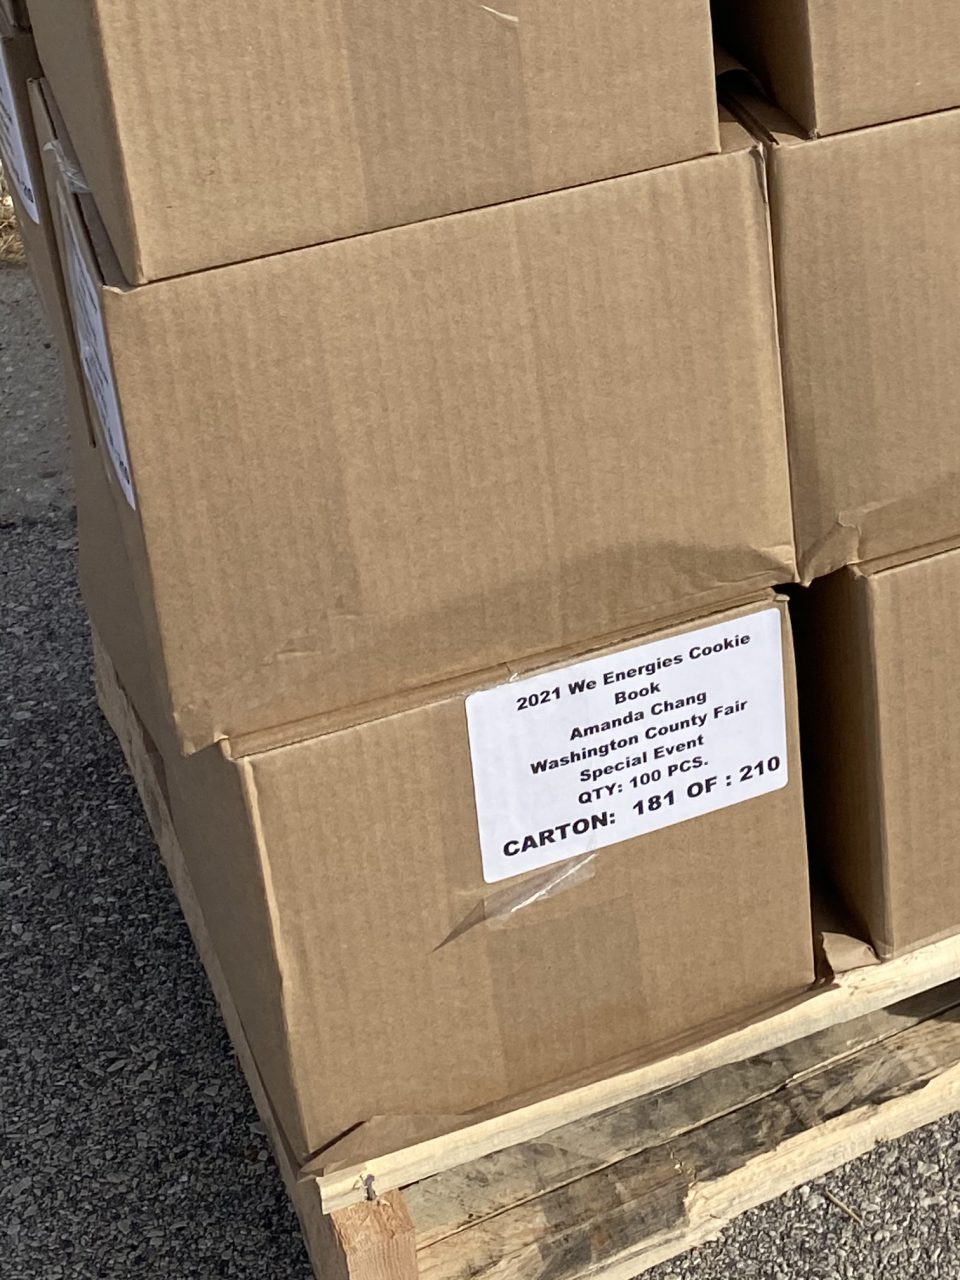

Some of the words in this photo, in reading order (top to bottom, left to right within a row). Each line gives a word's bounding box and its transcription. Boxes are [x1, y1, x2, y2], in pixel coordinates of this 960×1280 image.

[516, 686, 561, 712] 2021
[567, 678, 597, 696] We
[602, 654, 684, 686] Energies
[688, 634, 751, 660] Cookie
[614, 681, 661, 705] Book
[529, 734, 639, 775] Washington
[644, 713, 708, 740] County
[713, 700, 748, 720] Fair
[569, 710, 645, 741] Amanda
[650, 691, 707, 716] Chang
[578, 782, 623, 805] QTY:
[629, 769, 662, 789] 100
[667, 755, 709, 778] PCS.
[579, 751, 648, 782] Special
[653, 734, 704, 760] Event
[503, 811, 616, 857] CARTON:
[632, 789, 675, 816] 181
[739, 755, 781, 783] 210
